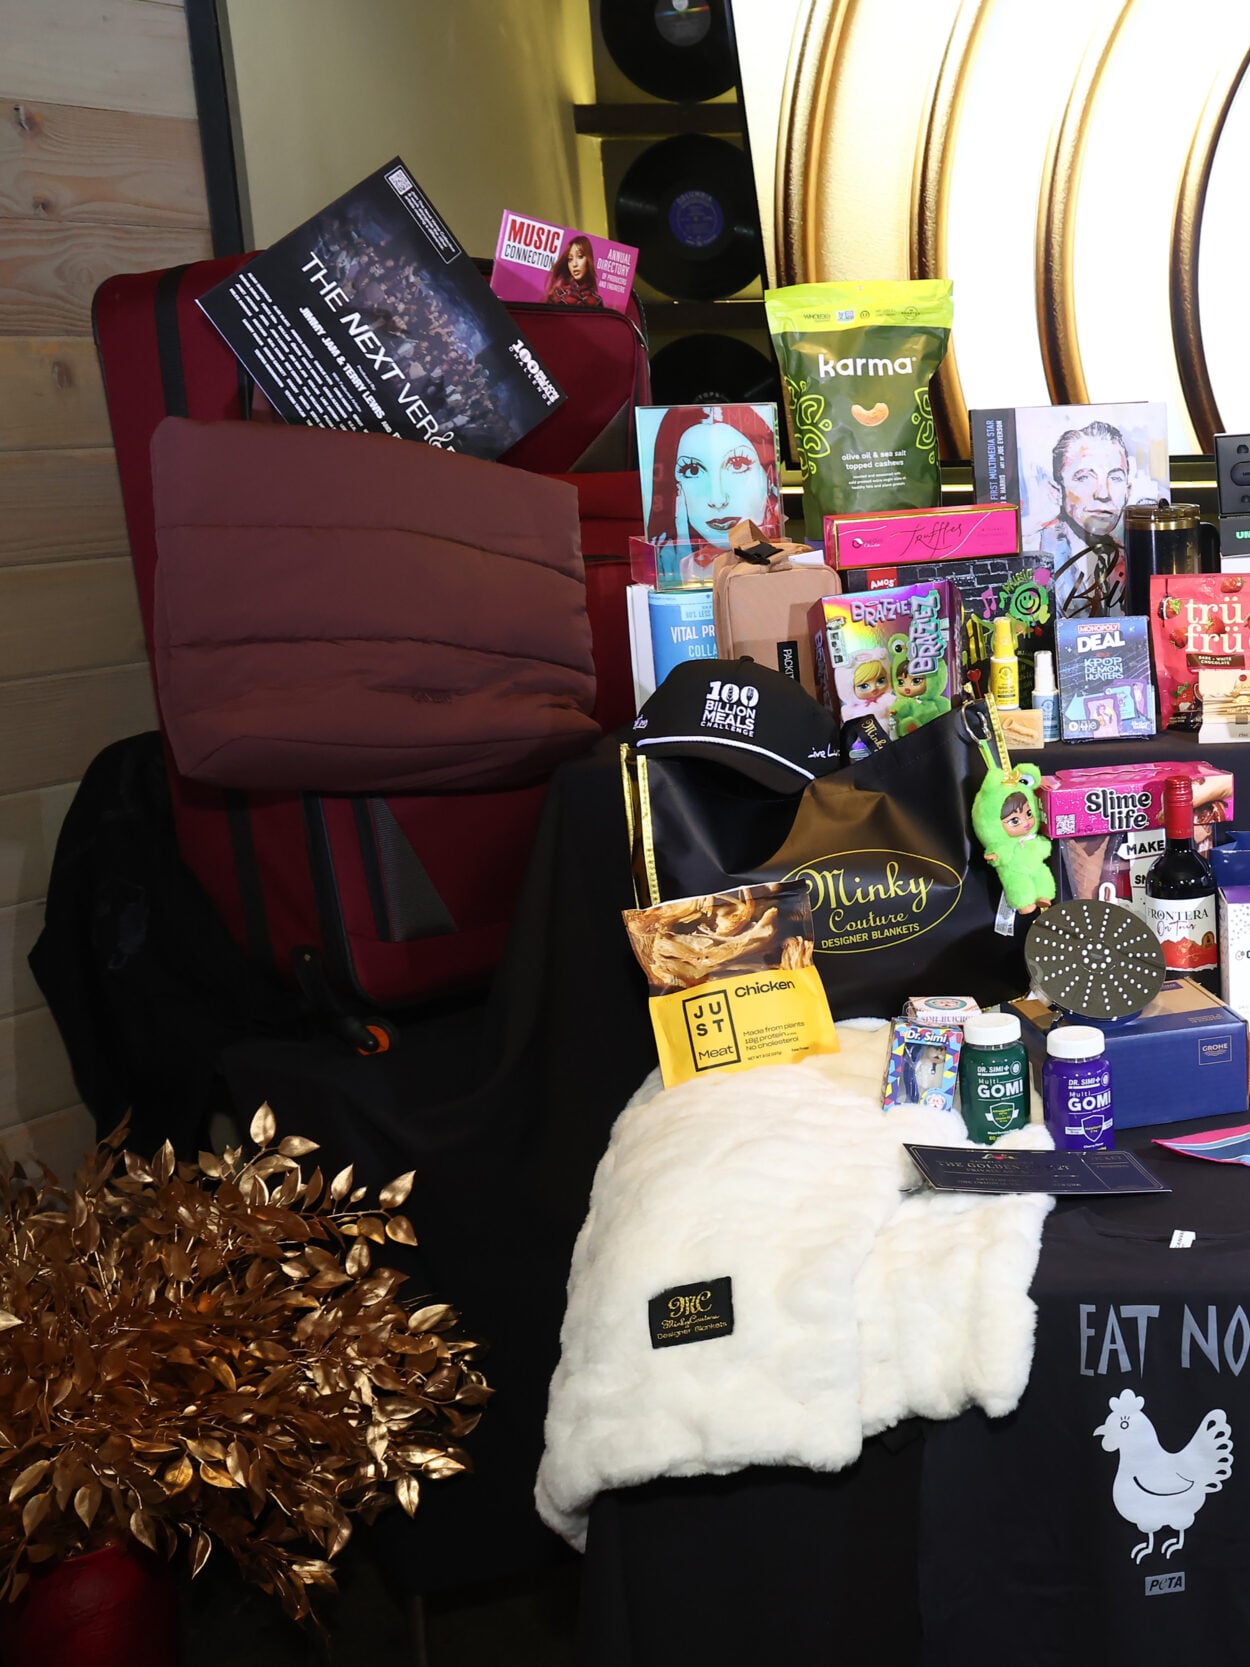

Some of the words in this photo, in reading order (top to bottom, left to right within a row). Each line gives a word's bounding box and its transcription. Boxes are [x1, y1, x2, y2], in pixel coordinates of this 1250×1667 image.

[508, 218, 561, 254] MUSIC
[504, 243, 556, 269] CONNECTION
[607, 248, 631, 266] ANNUAL
[597, 258, 630, 277] DIRECTORY
[301, 251, 350, 313] THE
[340, 311, 406, 380] NEXT
[298, 304, 326, 338] JIMMY
[320, 333, 340, 357] JAM
[335, 354, 347, 366] &
[341, 362, 367, 393] TERRY
[361, 390, 385, 420] LEWIS
[512, 339, 540, 374] 100
[818, 354, 913, 378] karma
[986, 420, 995, 437] STAR
[842, 453, 860, 461] olive
[861, 451, 871, 459] oil
[894, 449, 907, 457] salt
[988, 439, 997, 480] MULTIMEDIA
[845, 461, 873, 471] topped
[874, 459, 904, 468] cashews
[990, 482, 999, 500] FIRST
[870, 578, 895, 590] AMOS
[1185, 597, 1245, 624] trü
[671, 626, 699, 644] VITAL
[1080, 625, 1119, 633] MONOPOLY
[1185, 624, 1245, 653] frü
[1077, 631, 1125, 653] DEAL
[1085, 664, 1123, 674] DEMON
[1085, 673, 1124, 681] HUNTERS
[706, 681, 759, 707] 100
[705, 700, 757, 720] BILLION
[700, 721, 755, 738] CHALLENGE
[702, 710, 755, 731] MEALS
[1085, 788, 1152, 818] Slime
[1109, 808, 1150, 831] life
[1126, 839, 1165, 856] MAKE
[805, 861, 934, 916] Minky
[829, 911, 909, 933] Couture
[1147, 908, 1209, 921] FRONTERA
[821, 932, 869, 949] DESIGNER
[871, 922, 920, 942] BLANKETS
[735, 980, 796, 998] Chicken
[743, 1028, 765, 1037] Made
[765, 1025, 783, 1033] from
[784, 1021, 805, 1030] plants
[745, 1036, 758, 1044] 18g
[759, 1031, 786, 1042] protein
[907, 1030, 920, 1039] Dr.
[924, 1031, 947, 1043] Simi
[758, 1036, 799, 1049] cholesterol
[1202, 1043, 1228, 1052] GROHE
[698, 1045, 734, 1061] Meat
[977, 1079, 1023, 1098] GOMI
[1069, 1090, 1091, 1098] Multi
[1068, 1090, 1111, 1112] GOMI
[657, 1329, 691, 1340] Designer
[694, 1321, 728, 1332] Blankets
[661, 1318, 690, 1329] Minky
[1079, 1304, 1160, 1378] EAT
[1181, 1304, 1250, 1377] NO
